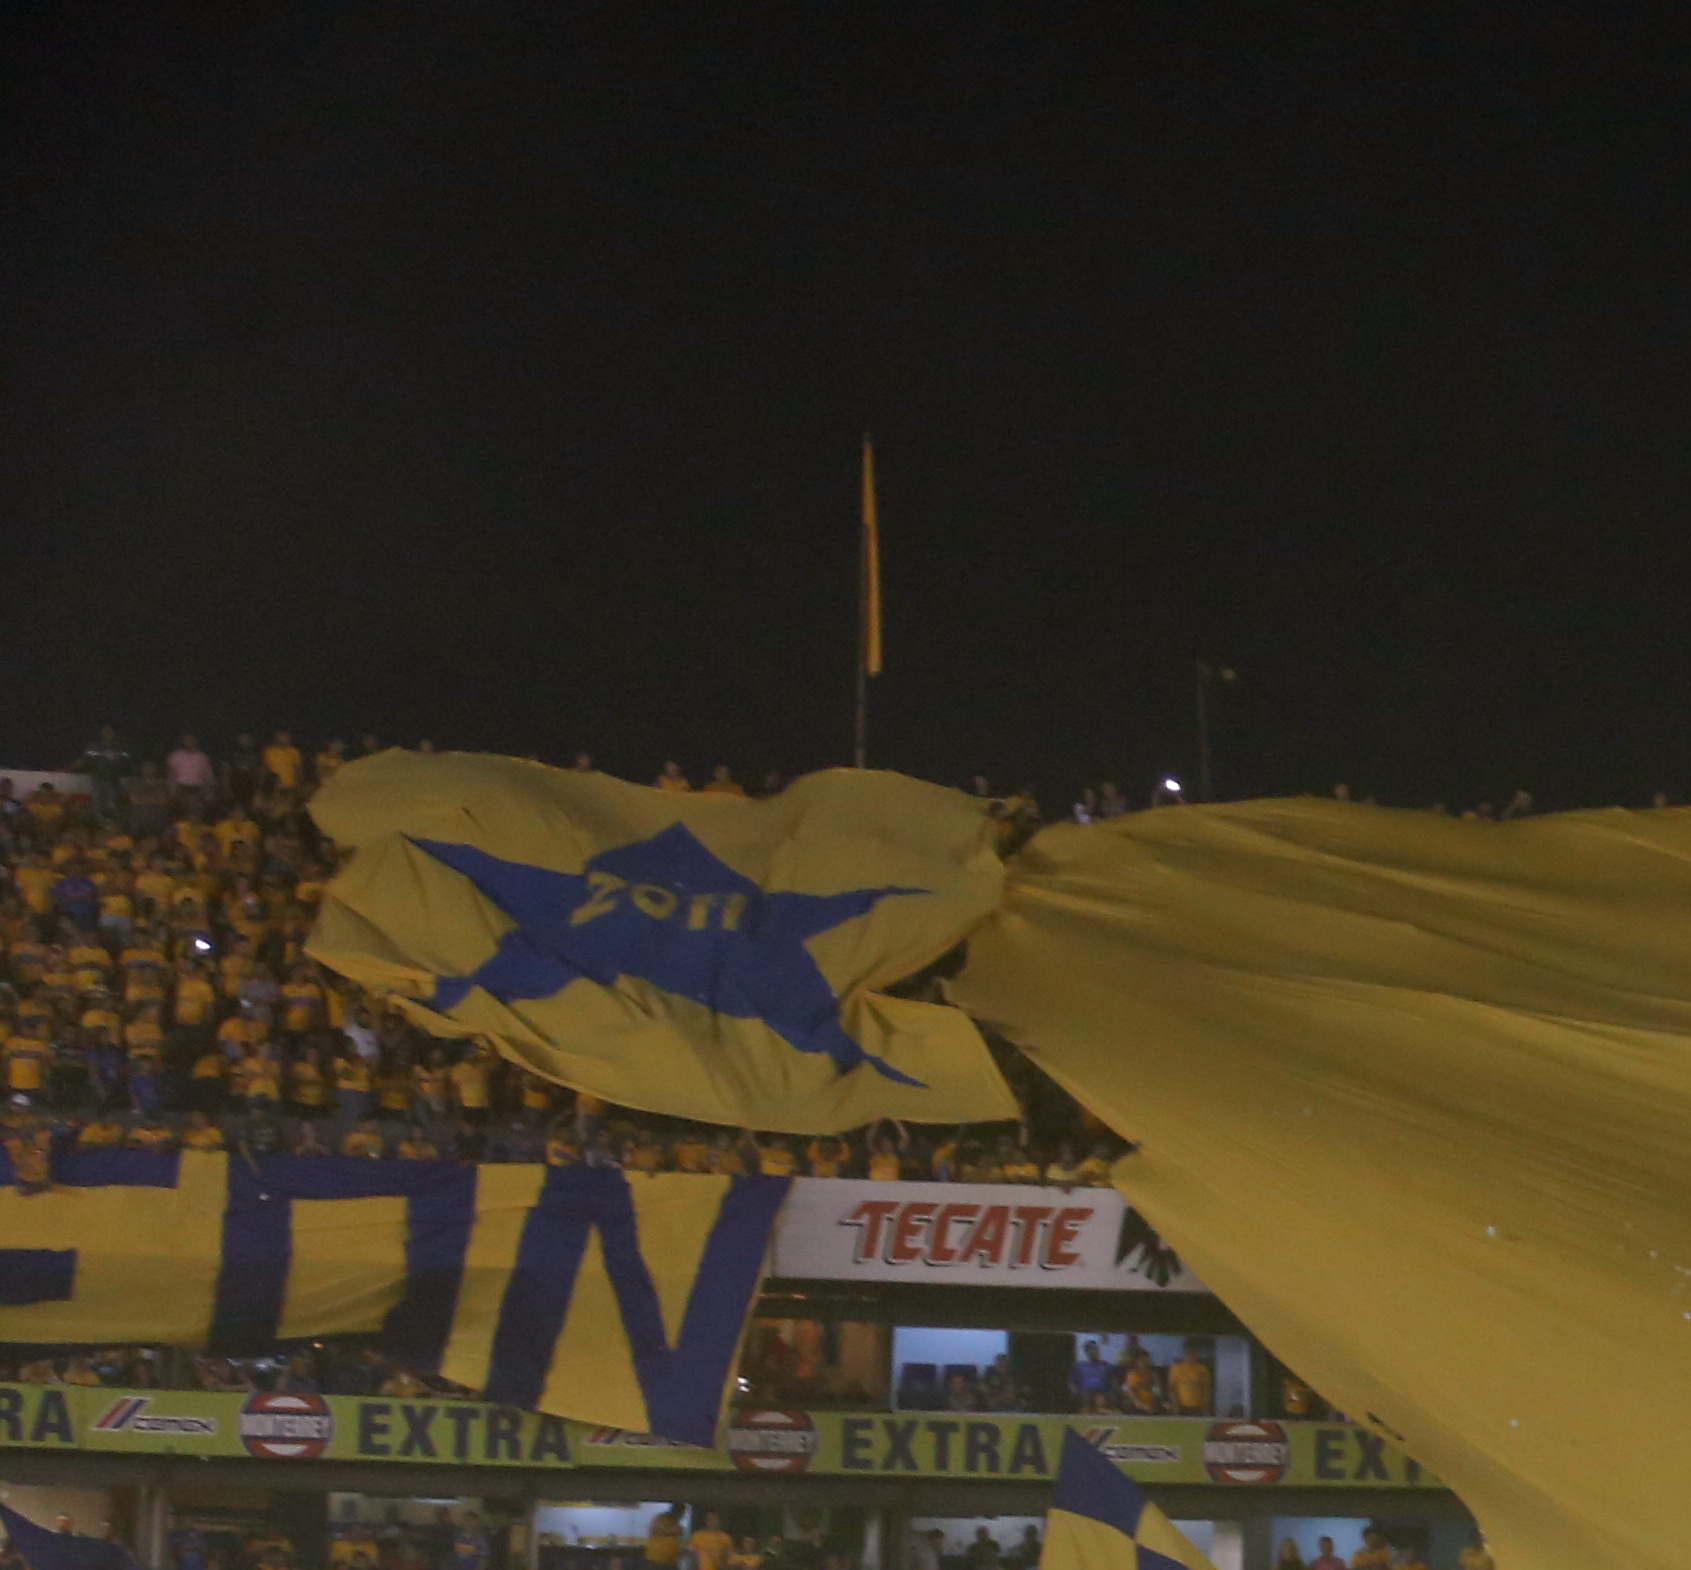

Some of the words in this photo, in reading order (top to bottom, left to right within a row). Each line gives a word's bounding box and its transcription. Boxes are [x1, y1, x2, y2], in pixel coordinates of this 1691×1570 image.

[840, 1199, 1095, 1268] TECATE
[358, 1402, 572, 1463] EXTRA
[841, 1417, 1048, 1475] EXTRA
